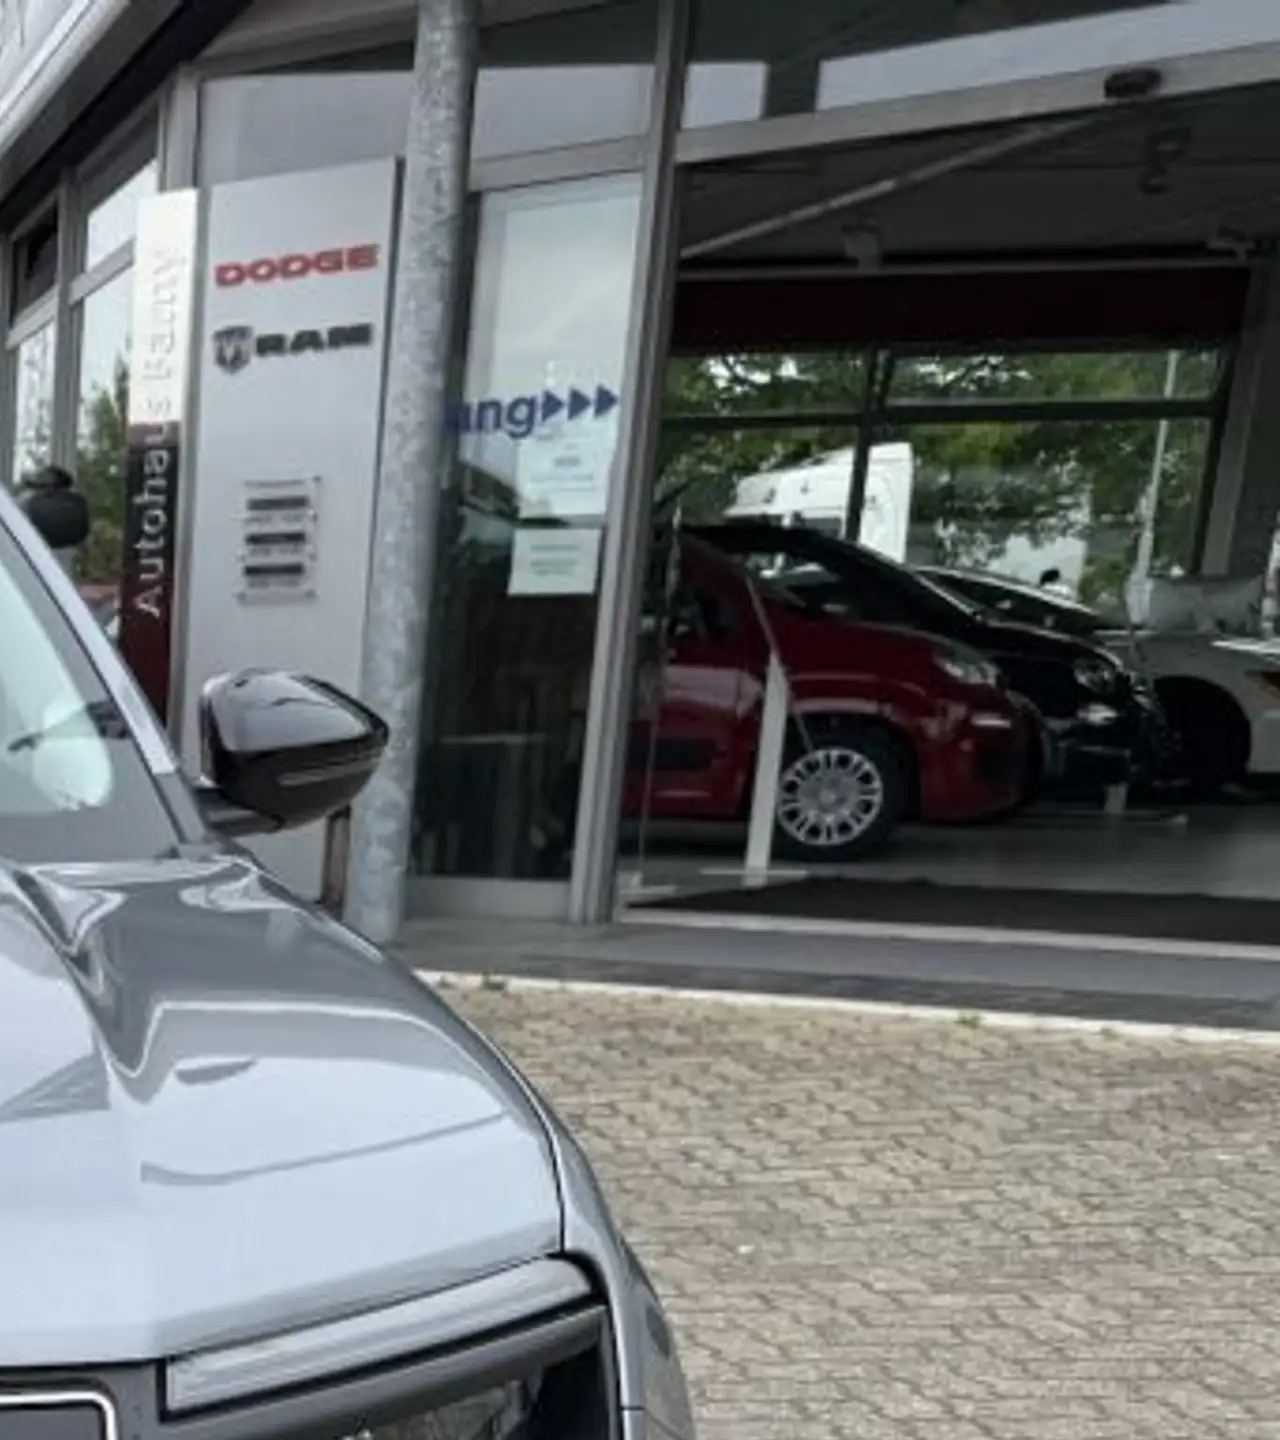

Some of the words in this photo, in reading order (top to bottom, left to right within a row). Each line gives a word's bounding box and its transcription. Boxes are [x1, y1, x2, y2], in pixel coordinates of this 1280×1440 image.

[214, 244, 380, 287] DODGE
[255, 323, 373, 357] RAM
[133, 399, 172, 617] Autohaus
